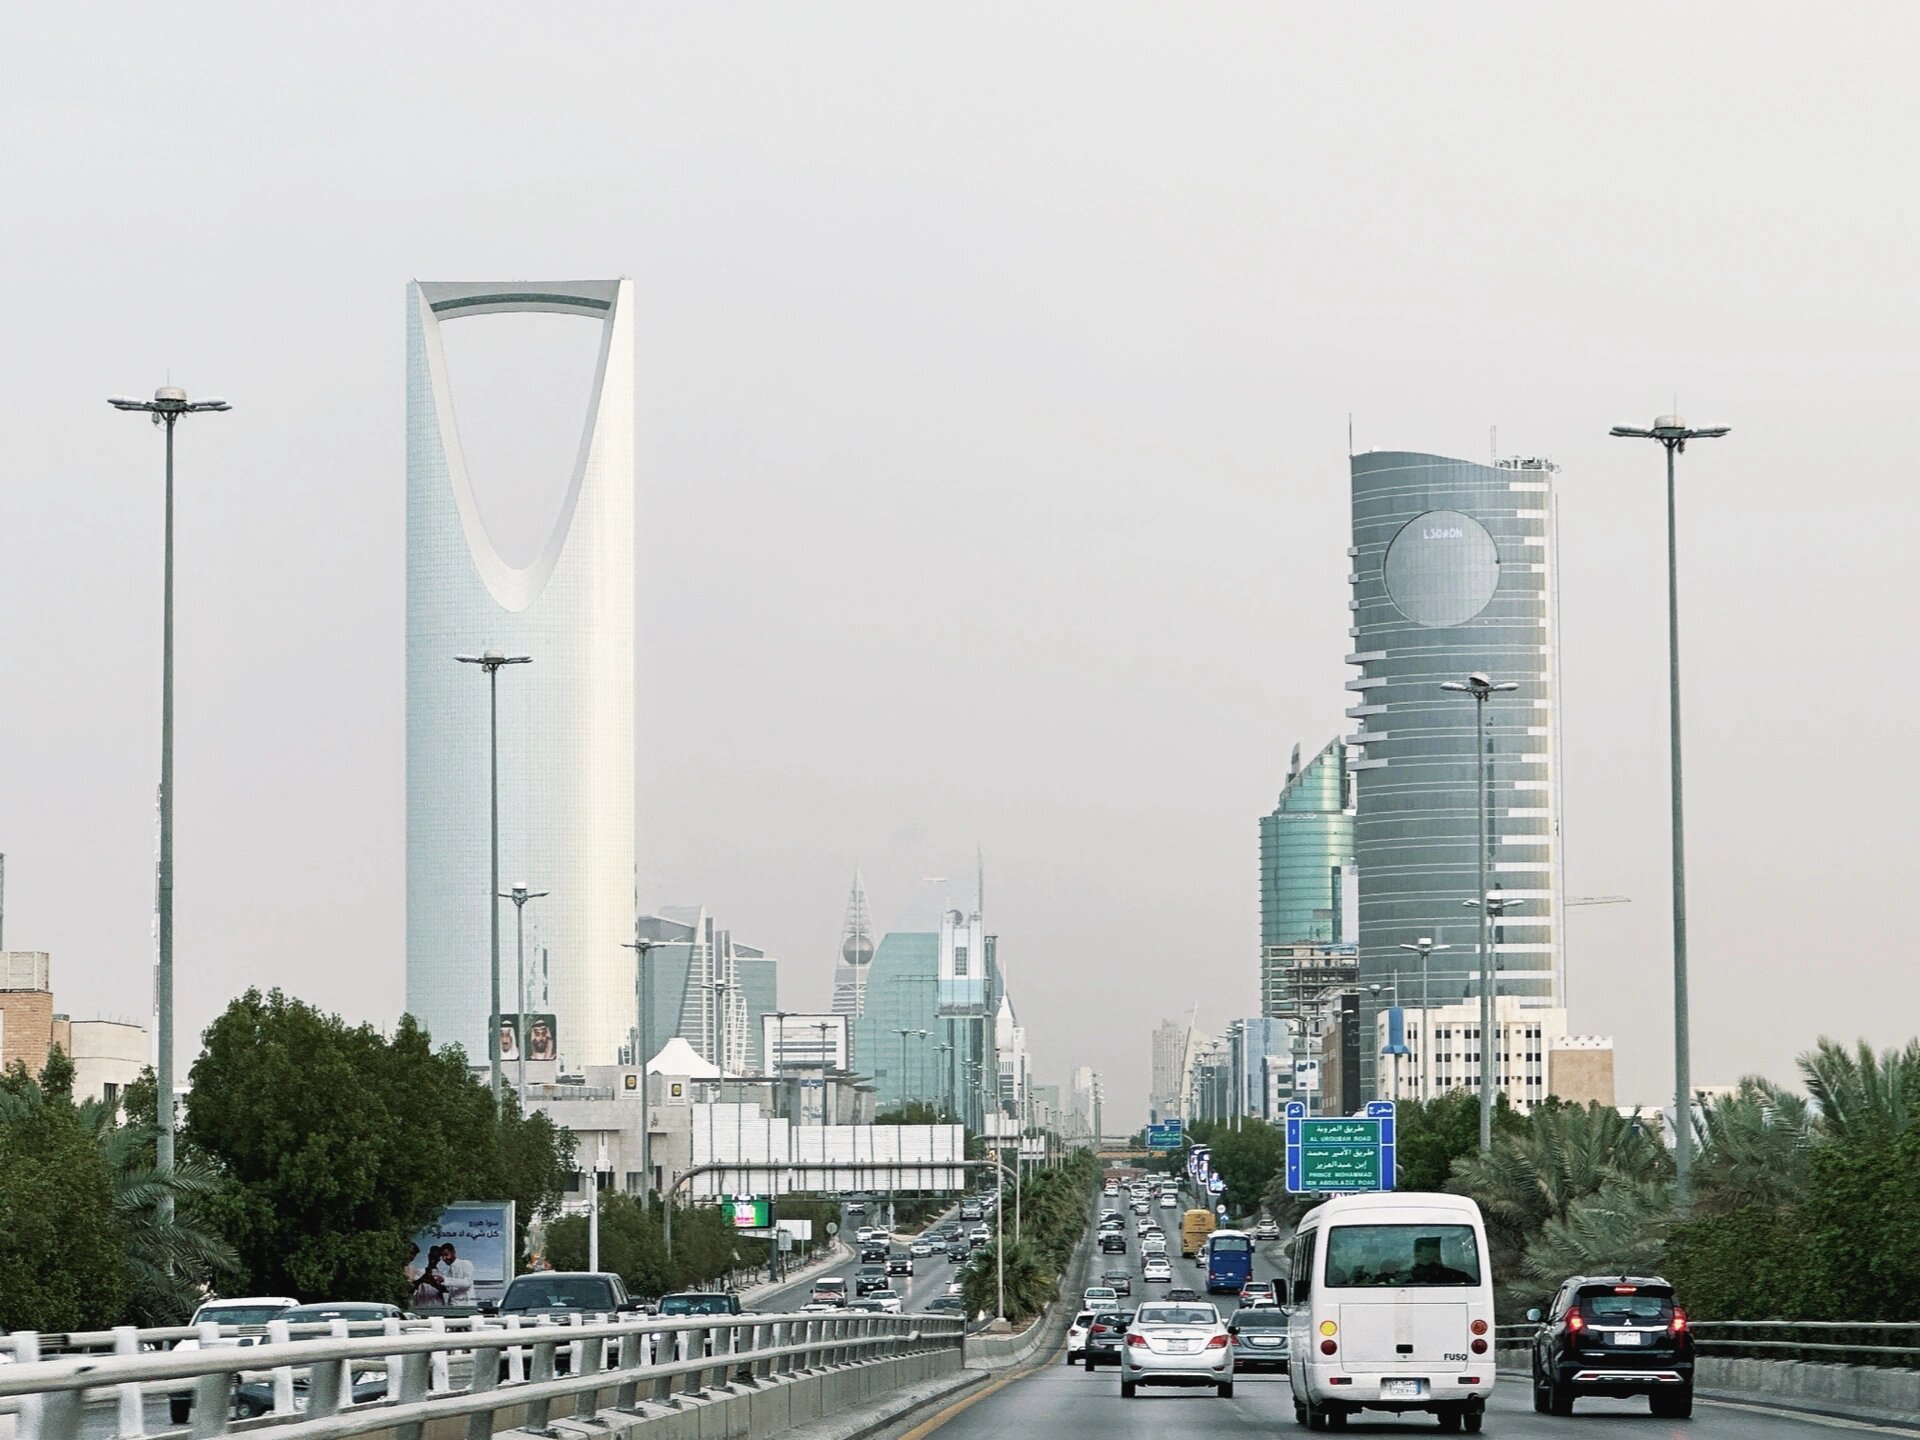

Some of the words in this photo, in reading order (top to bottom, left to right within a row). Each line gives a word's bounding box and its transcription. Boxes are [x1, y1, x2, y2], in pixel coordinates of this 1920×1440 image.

[1290, 1105, 1300, 1115] كم
[1369, 1105, 1392, 1115] مخرج
[1316, 1124, 1343, 1134] العروبة
[1344, 1124, 1365, 1134] طريق
[1352, 1148, 1375, 1158] طريق
[466, 1229, 486, 1241] شيء
[486, 1229, 500, 1239] كل
[1443, 1353, 1468, 1361] FUSO
